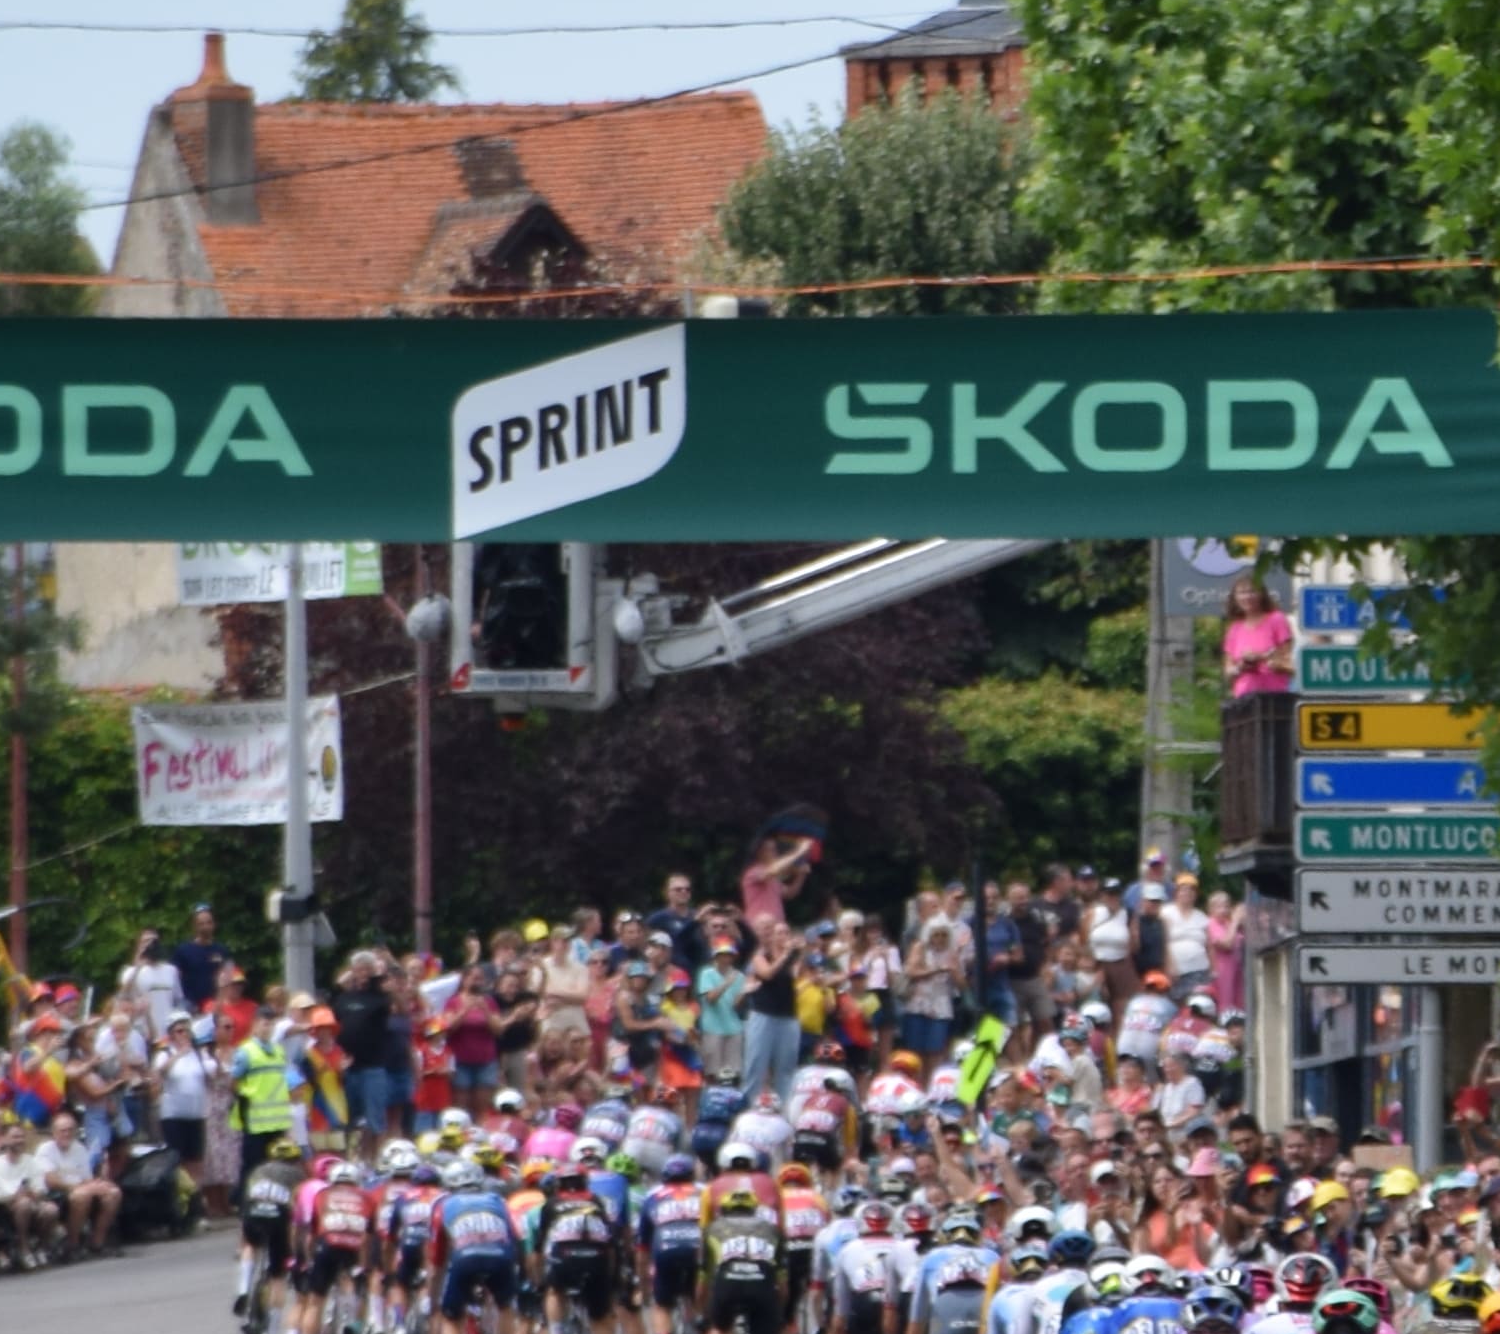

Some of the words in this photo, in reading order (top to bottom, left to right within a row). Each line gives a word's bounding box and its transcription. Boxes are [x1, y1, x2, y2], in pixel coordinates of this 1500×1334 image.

[467, 366, 673, 493] SPRINT
[1315, 715, 1330, 739] S
[1339, 715, 1357, 739] 4
[1403, 957, 1432, 976] LE
